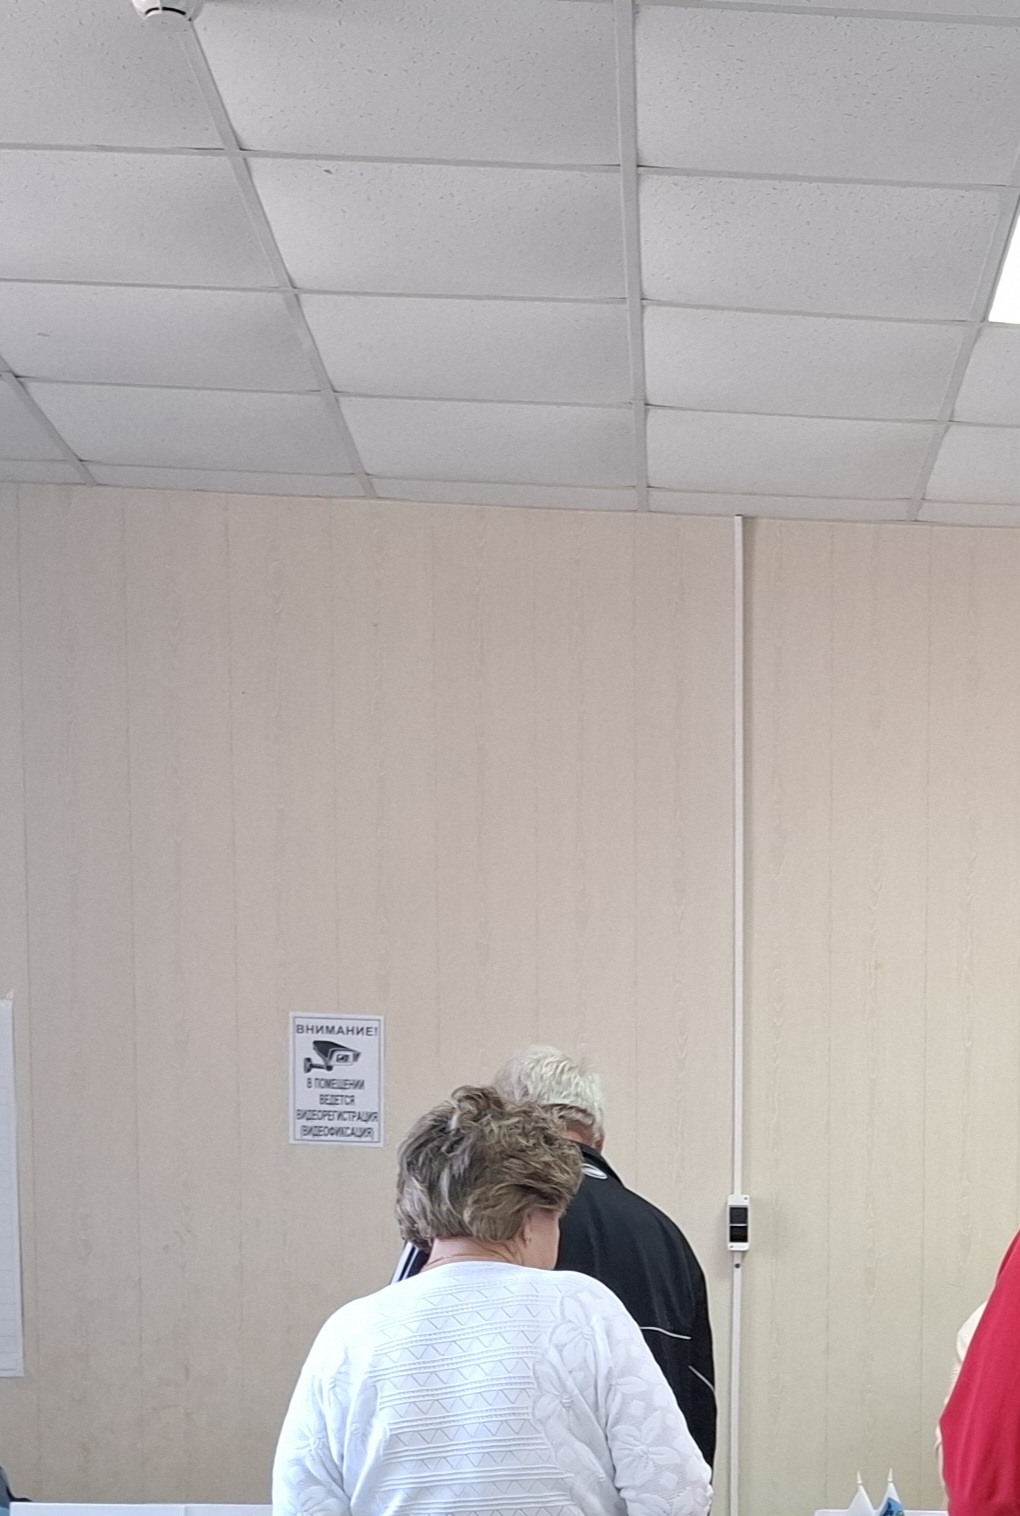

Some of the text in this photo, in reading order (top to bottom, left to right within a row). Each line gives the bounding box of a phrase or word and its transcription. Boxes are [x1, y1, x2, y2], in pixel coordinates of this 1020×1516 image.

[296, 1024, 378, 1036] ВНИМАНИЕ!
[306, 1077, 365, 1090] В ПОМЕЩЕНИИ
[319, 1094, 356, 1105] ВЕДЕТСЯ
[296, 1109, 379, 1122] ВИДЕОРЕГИСТРАЦИЯ
